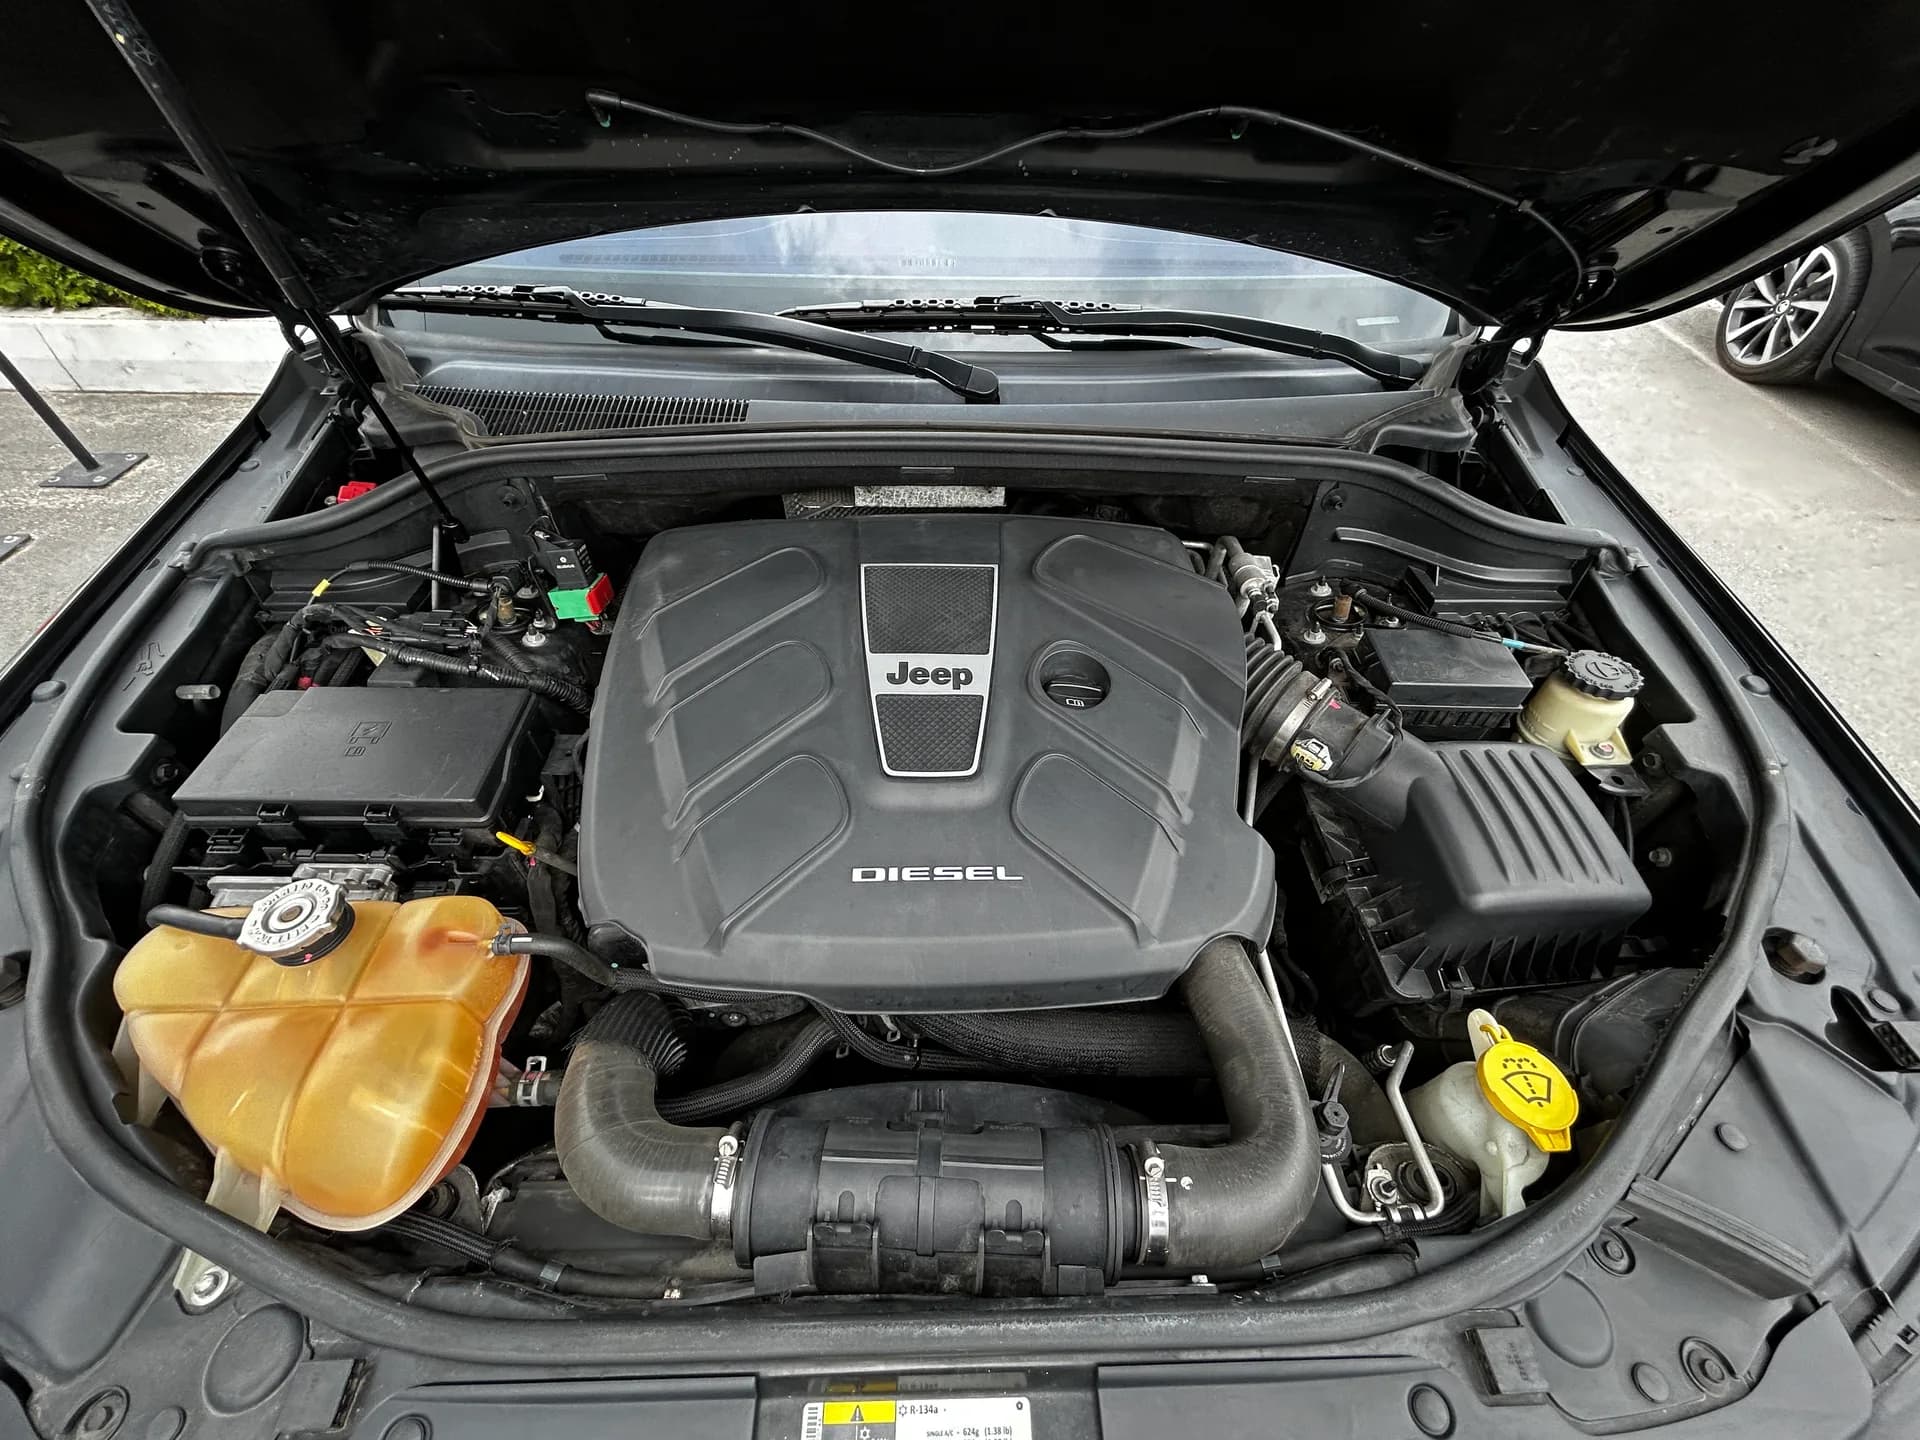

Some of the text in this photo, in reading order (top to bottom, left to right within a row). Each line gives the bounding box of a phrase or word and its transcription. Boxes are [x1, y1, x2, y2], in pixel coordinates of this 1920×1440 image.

[886, 661, 973, 690] Jeep
[851, 866, 1024, 882] DIESEL
[910, 1404, 939, 1415] R-134a
[962, 1427, 980, 1438] 624g
[984, 1426, 1002, 1437] (1.38
